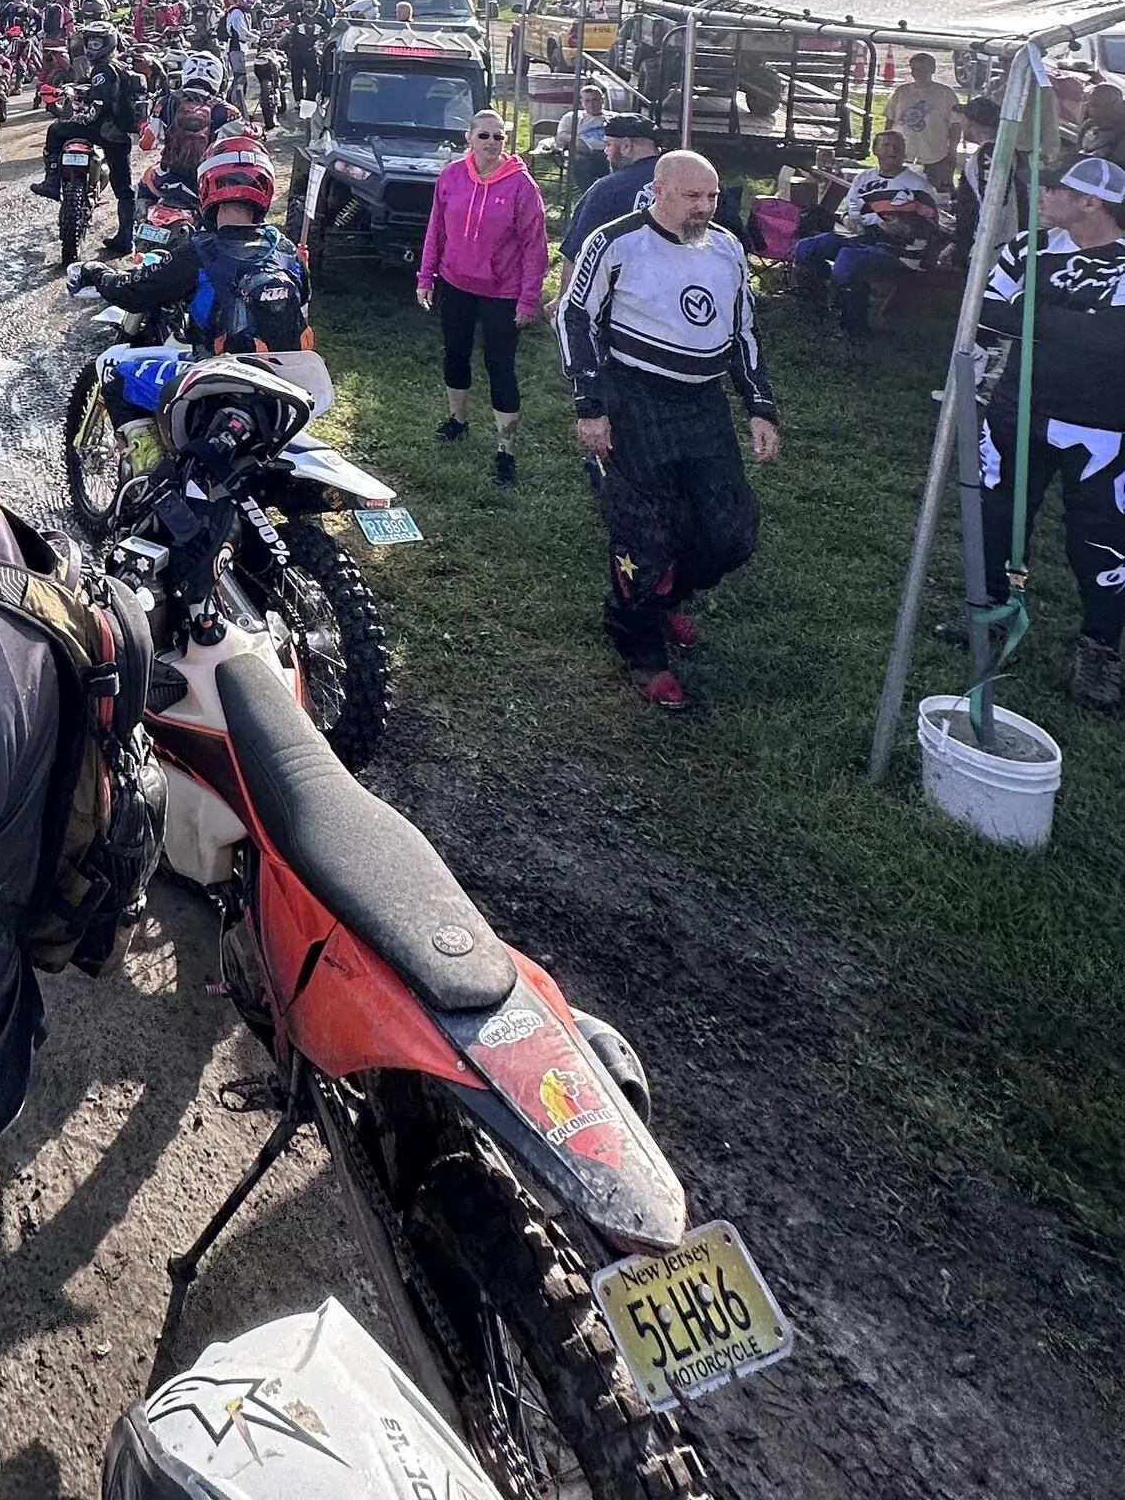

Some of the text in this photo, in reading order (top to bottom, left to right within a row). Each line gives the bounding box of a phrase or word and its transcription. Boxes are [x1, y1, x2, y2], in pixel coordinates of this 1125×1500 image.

[259, 287, 289, 301] KTM
[224, 362, 258, 379] THOR
[239, 495, 291, 566] 100%
[550, 1109, 614, 1143] TACOMOTO
[618, 1241, 711, 1291] New Jersey
[673, 1334, 763, 1389] MOTORCYCLE
